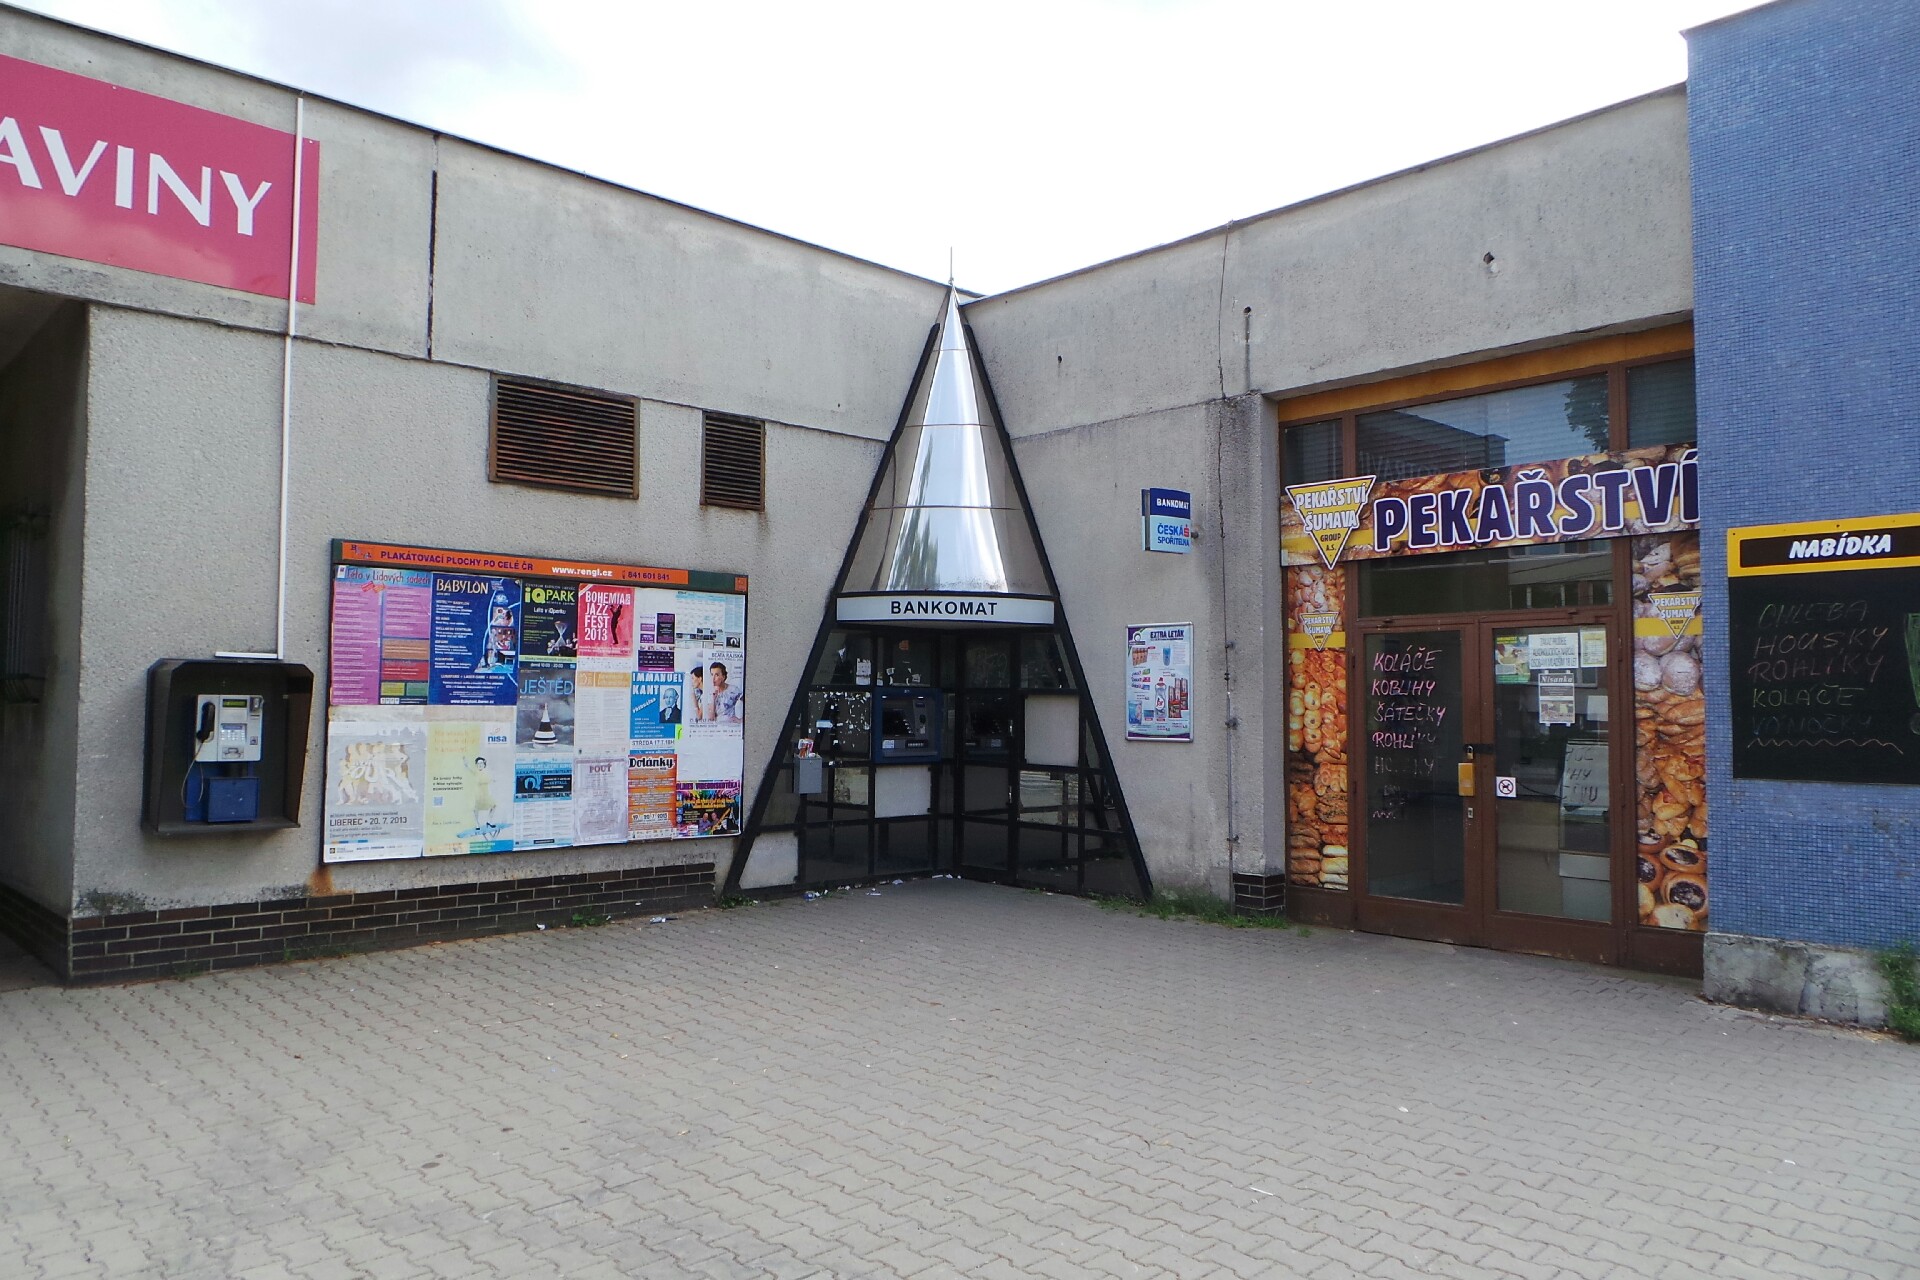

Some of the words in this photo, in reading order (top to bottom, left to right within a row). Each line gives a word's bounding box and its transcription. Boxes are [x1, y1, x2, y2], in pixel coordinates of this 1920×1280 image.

[1295, 482, 1367, 509] PEKAŘSTVÍ
[1374, 448, 1700, 551] PEKAŘSTVÍ
[1156, 498, 1190, 510] BANKOMAT
[1305, 510, 1357, 531] ŠUMAVA
[1157, 523, 1184, 536] ČESKÁ
[1157, 536, 1190, 546] SPOŘITELNA
[1320, 533, 1341, 542] GROUP
[1789, 533, 1892, 559] NABÍDKA
[380, 549, 445, 564] PLAKÁTOVACÍ
[446, 556, 481, 567] PLOCHY
[483, 560, 495, 568] PO
[497, 559, 519, 569] CELÉ
[521, 560, 534, 571] ČR
[551, 565, 613, 578] www.rengl.cz
[436, 579, 489, 595] BABYLON
[585, 591, 624, 606] BOHEMIA
[584, 603, 608, 616] JAZZ
[890, 600, 998, 616] BANKOMAT
[584, 615, 610, 629] FEST
[584, 628, 608, 641] 2013
[1150, 630, 1167, 639] EXTRA
[1168, 629, 1184, 638] LETÁK
[1753, 627, 1888, 658] HOUSKY
[1373, 645, 1442, 672] KOLÁČE
[632, 672, 683, 683] IMMANUEL
[1541, 675, 1573, 684] Nisanka
[519, 676, 574, 696] JEŠTĚD
[632, 684, 660, 695] KANT
[1372, 680, 1436, 696] KOBLIHY
[1373, 701, 1447, 726] ŠÁTEČKY
[628, 756, 674, 769] Dolánky
[329, 817, 363, 827] LIBEREC
[369, 816, 381, 826] 20.
[382, 816, 389, 825] 7.
[390, 816, 408, 825] 2013
